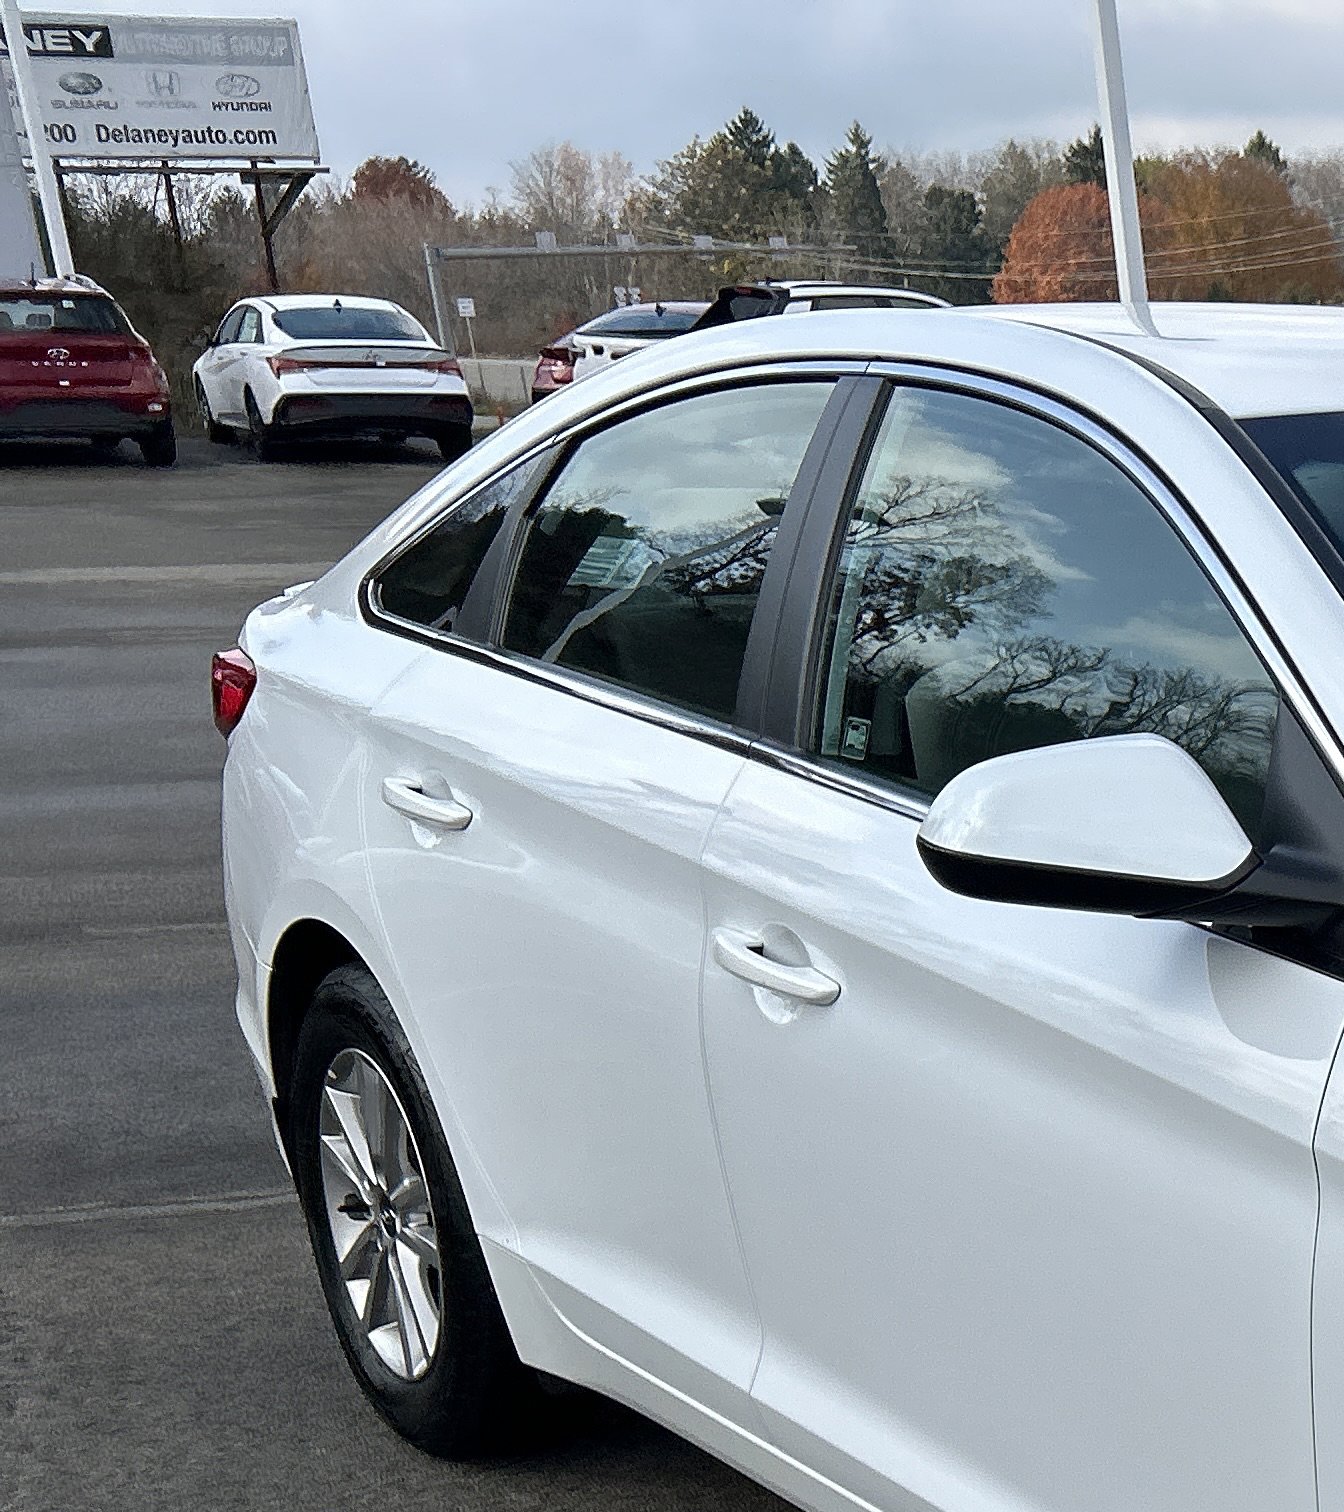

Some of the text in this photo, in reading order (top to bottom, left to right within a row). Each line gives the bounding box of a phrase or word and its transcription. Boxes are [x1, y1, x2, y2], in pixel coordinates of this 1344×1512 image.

[0, 29, 102, 52] NEY
[211, 101, 272, 112] HYUNDAI
[95, 124, 278, 147] Delaneyauto.com
